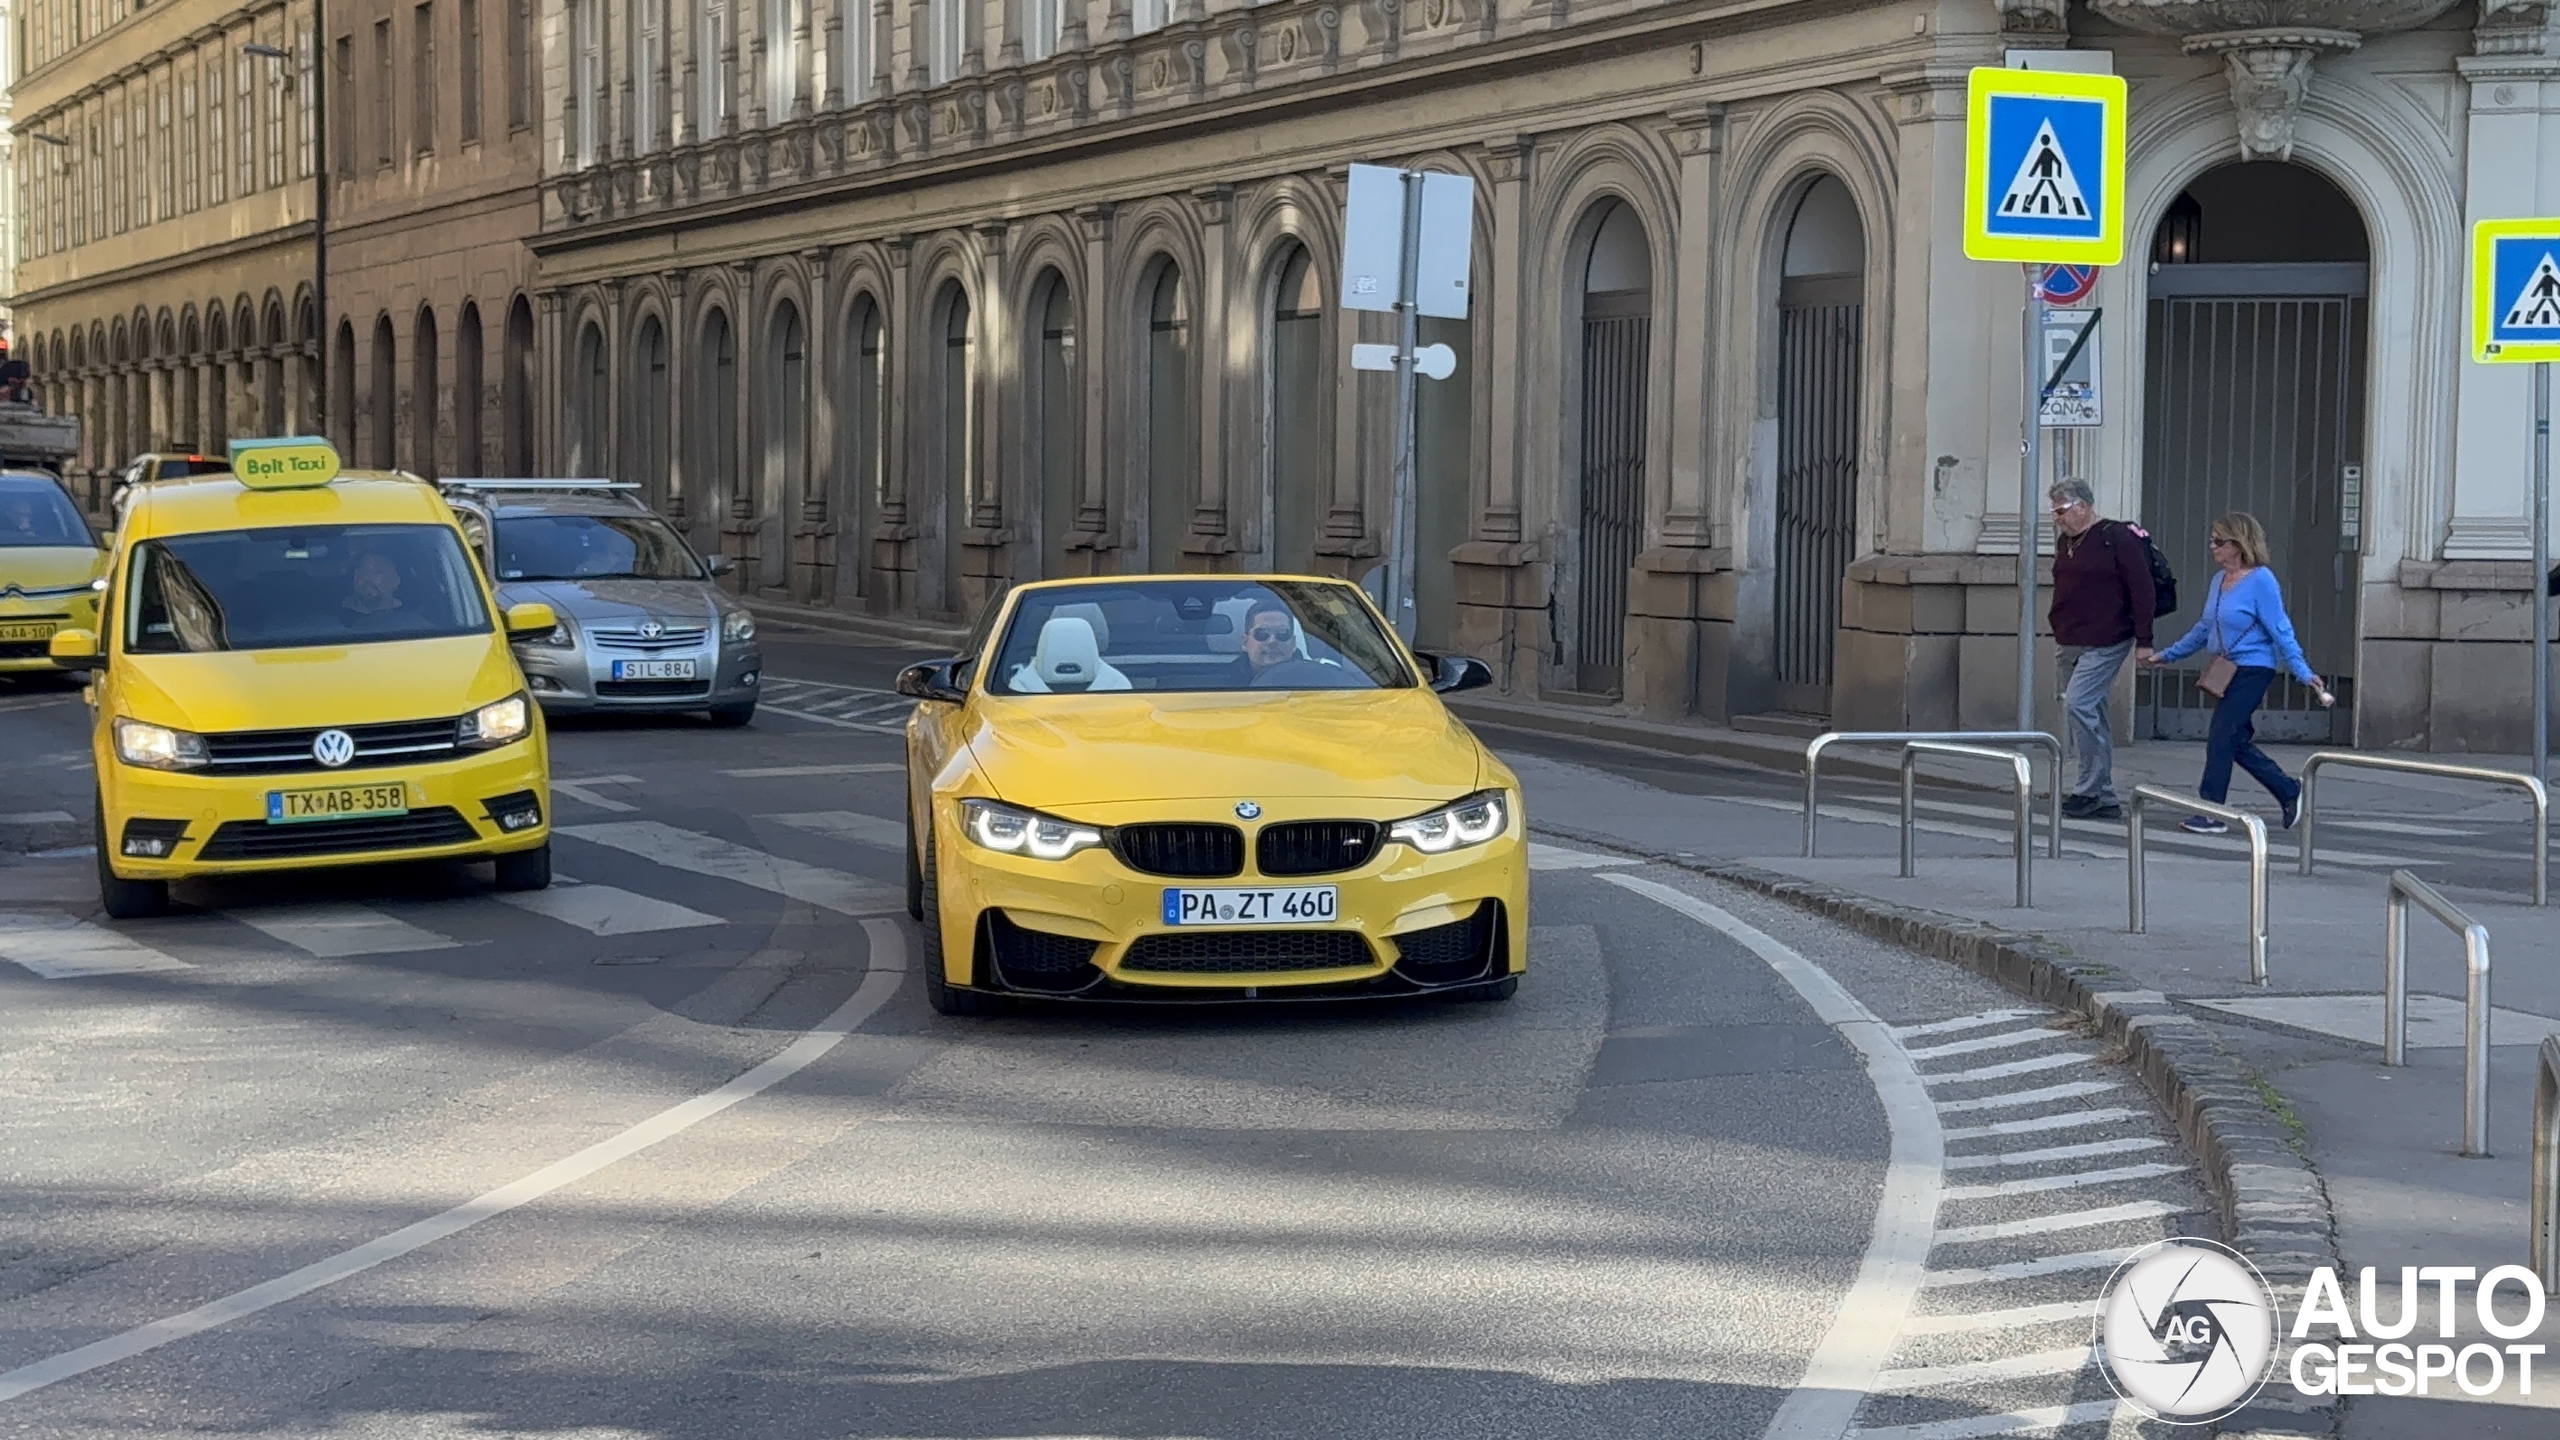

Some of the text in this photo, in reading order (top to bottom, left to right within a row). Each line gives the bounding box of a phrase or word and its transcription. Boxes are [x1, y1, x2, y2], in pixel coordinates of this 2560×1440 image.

[247, 455, 326, 477] Bolt Taxi
[626, 662, 691, 677] SIL-884
[286, 787, 400, 815] TX AB-358
[1182, 890, 1334, 919] PA ZT 460
